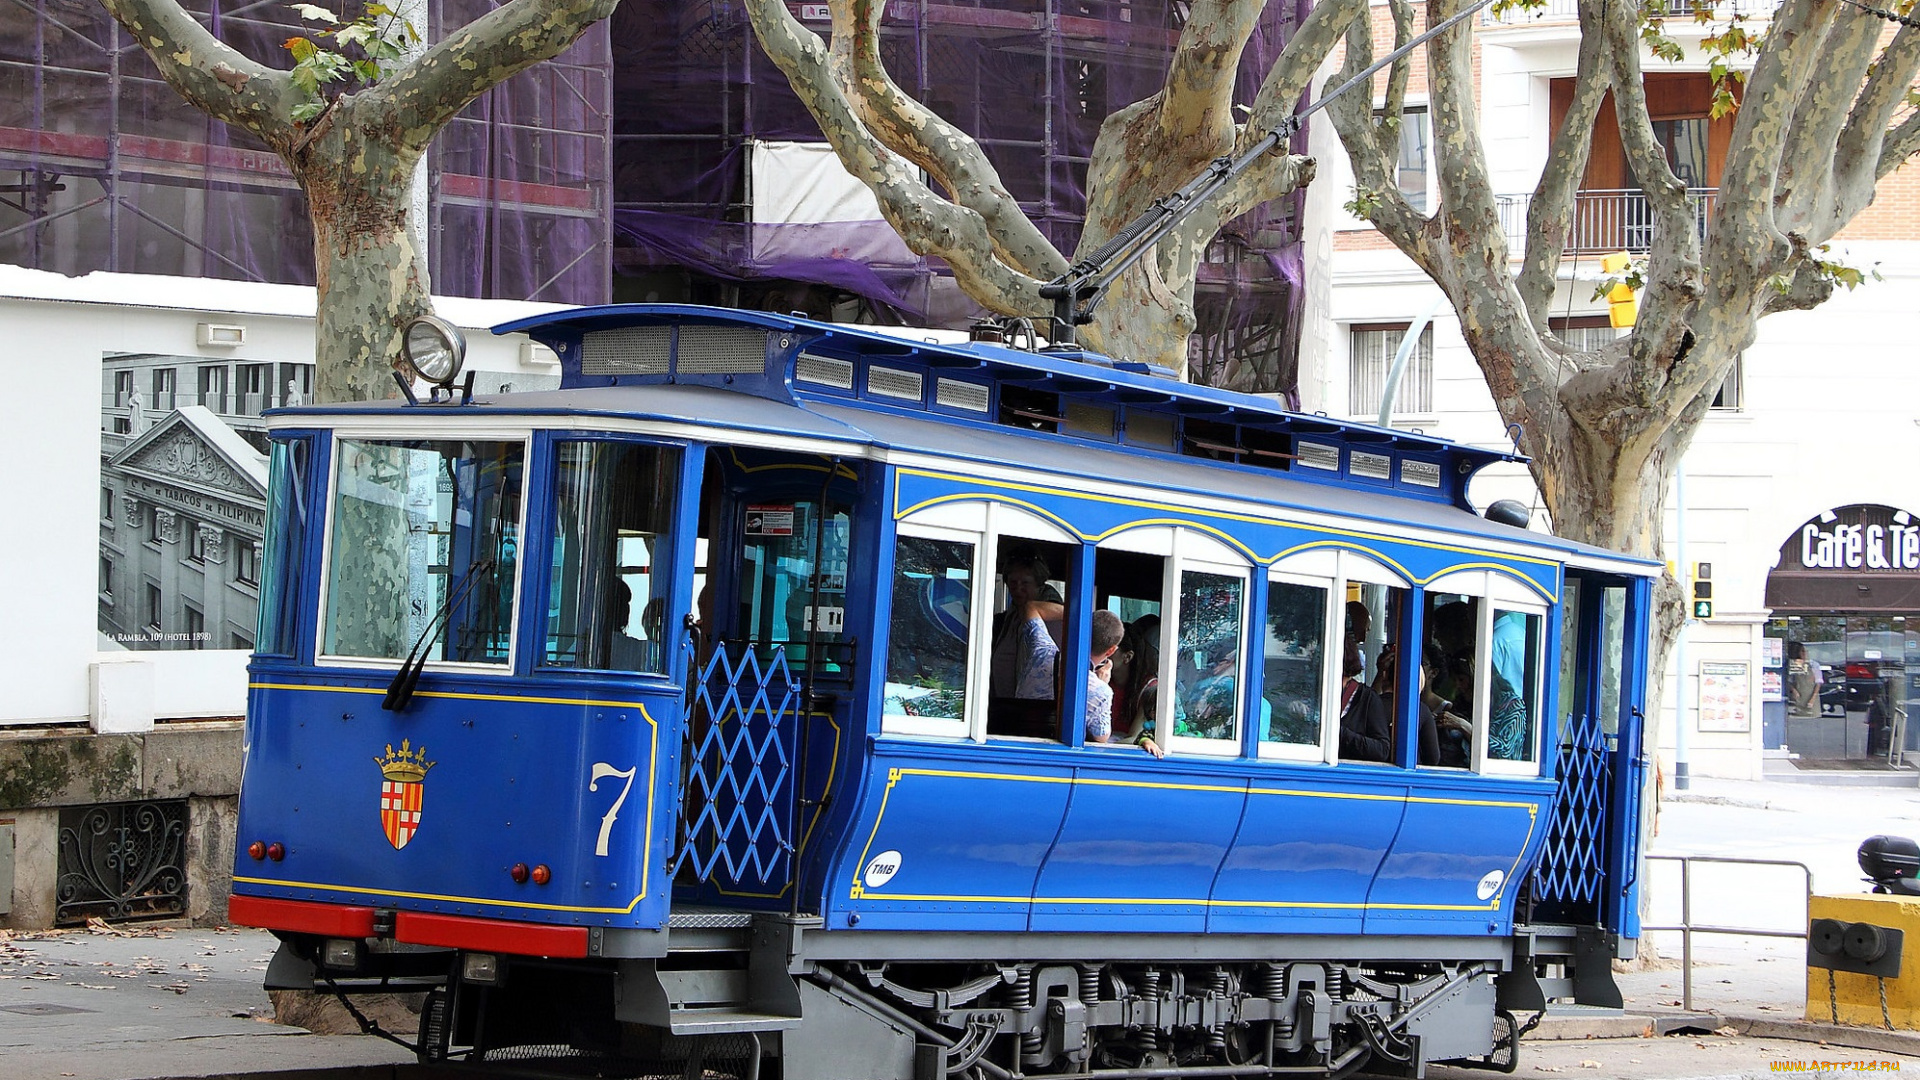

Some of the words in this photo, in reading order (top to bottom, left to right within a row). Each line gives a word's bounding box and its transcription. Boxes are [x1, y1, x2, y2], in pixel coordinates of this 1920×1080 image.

[163, 487, 202, 508] TABACOS
[217, 504, 265, 528] FILIPINA
[1802, 523, 1862, 569] Café
[1866, 523, 1891, 569] &
[1889, 525, 1920, 569] Té
[150, 632, 163, 642] 109
[164, 632, 191, 642] (HOTEL
[192, 632, 212, 642] 1898)
[588, 762, 637, 857] 7
[872, 864, 895, 875] TMB
